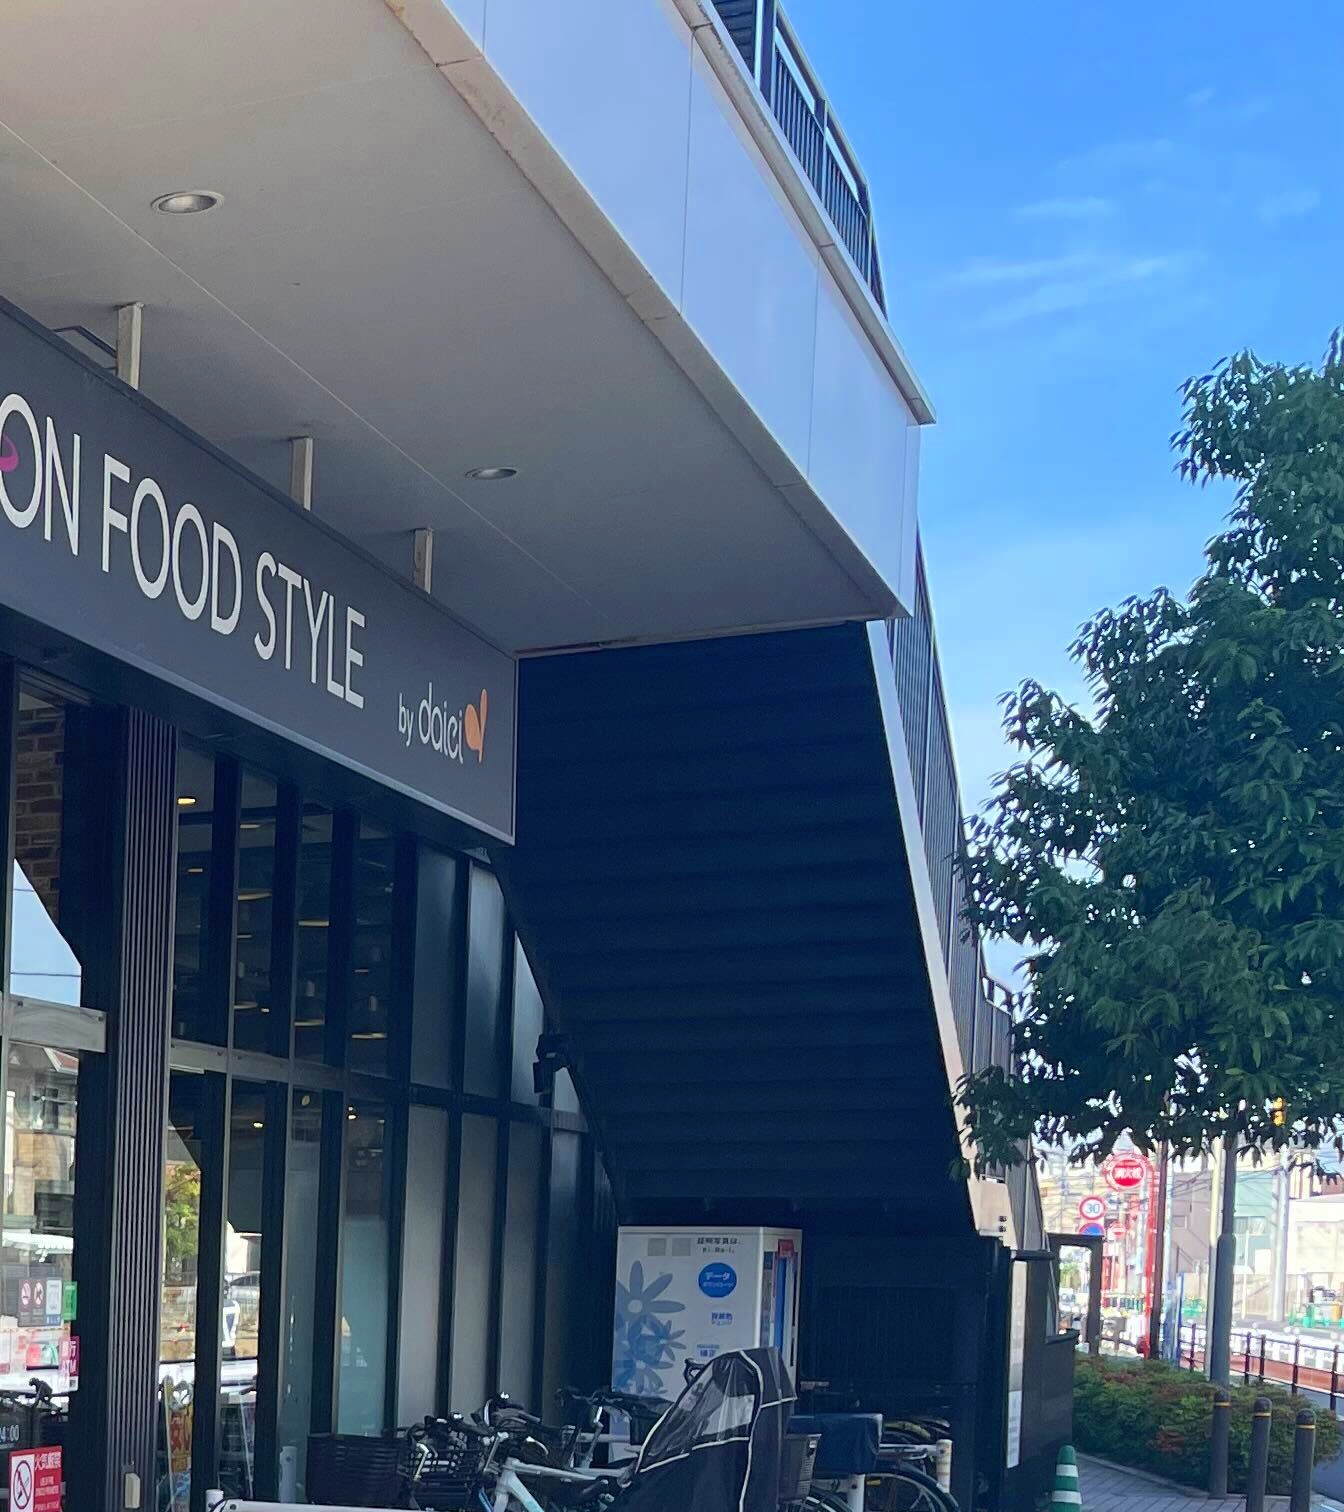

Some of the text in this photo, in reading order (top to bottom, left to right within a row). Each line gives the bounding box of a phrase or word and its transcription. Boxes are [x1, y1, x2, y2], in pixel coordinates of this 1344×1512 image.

[102, 452, 243, 636] FOOD
[254, 551, 366, 710] STYLE
[398, 692, 414, 748] by
[1085, 1203, 1101, 1214] 30
